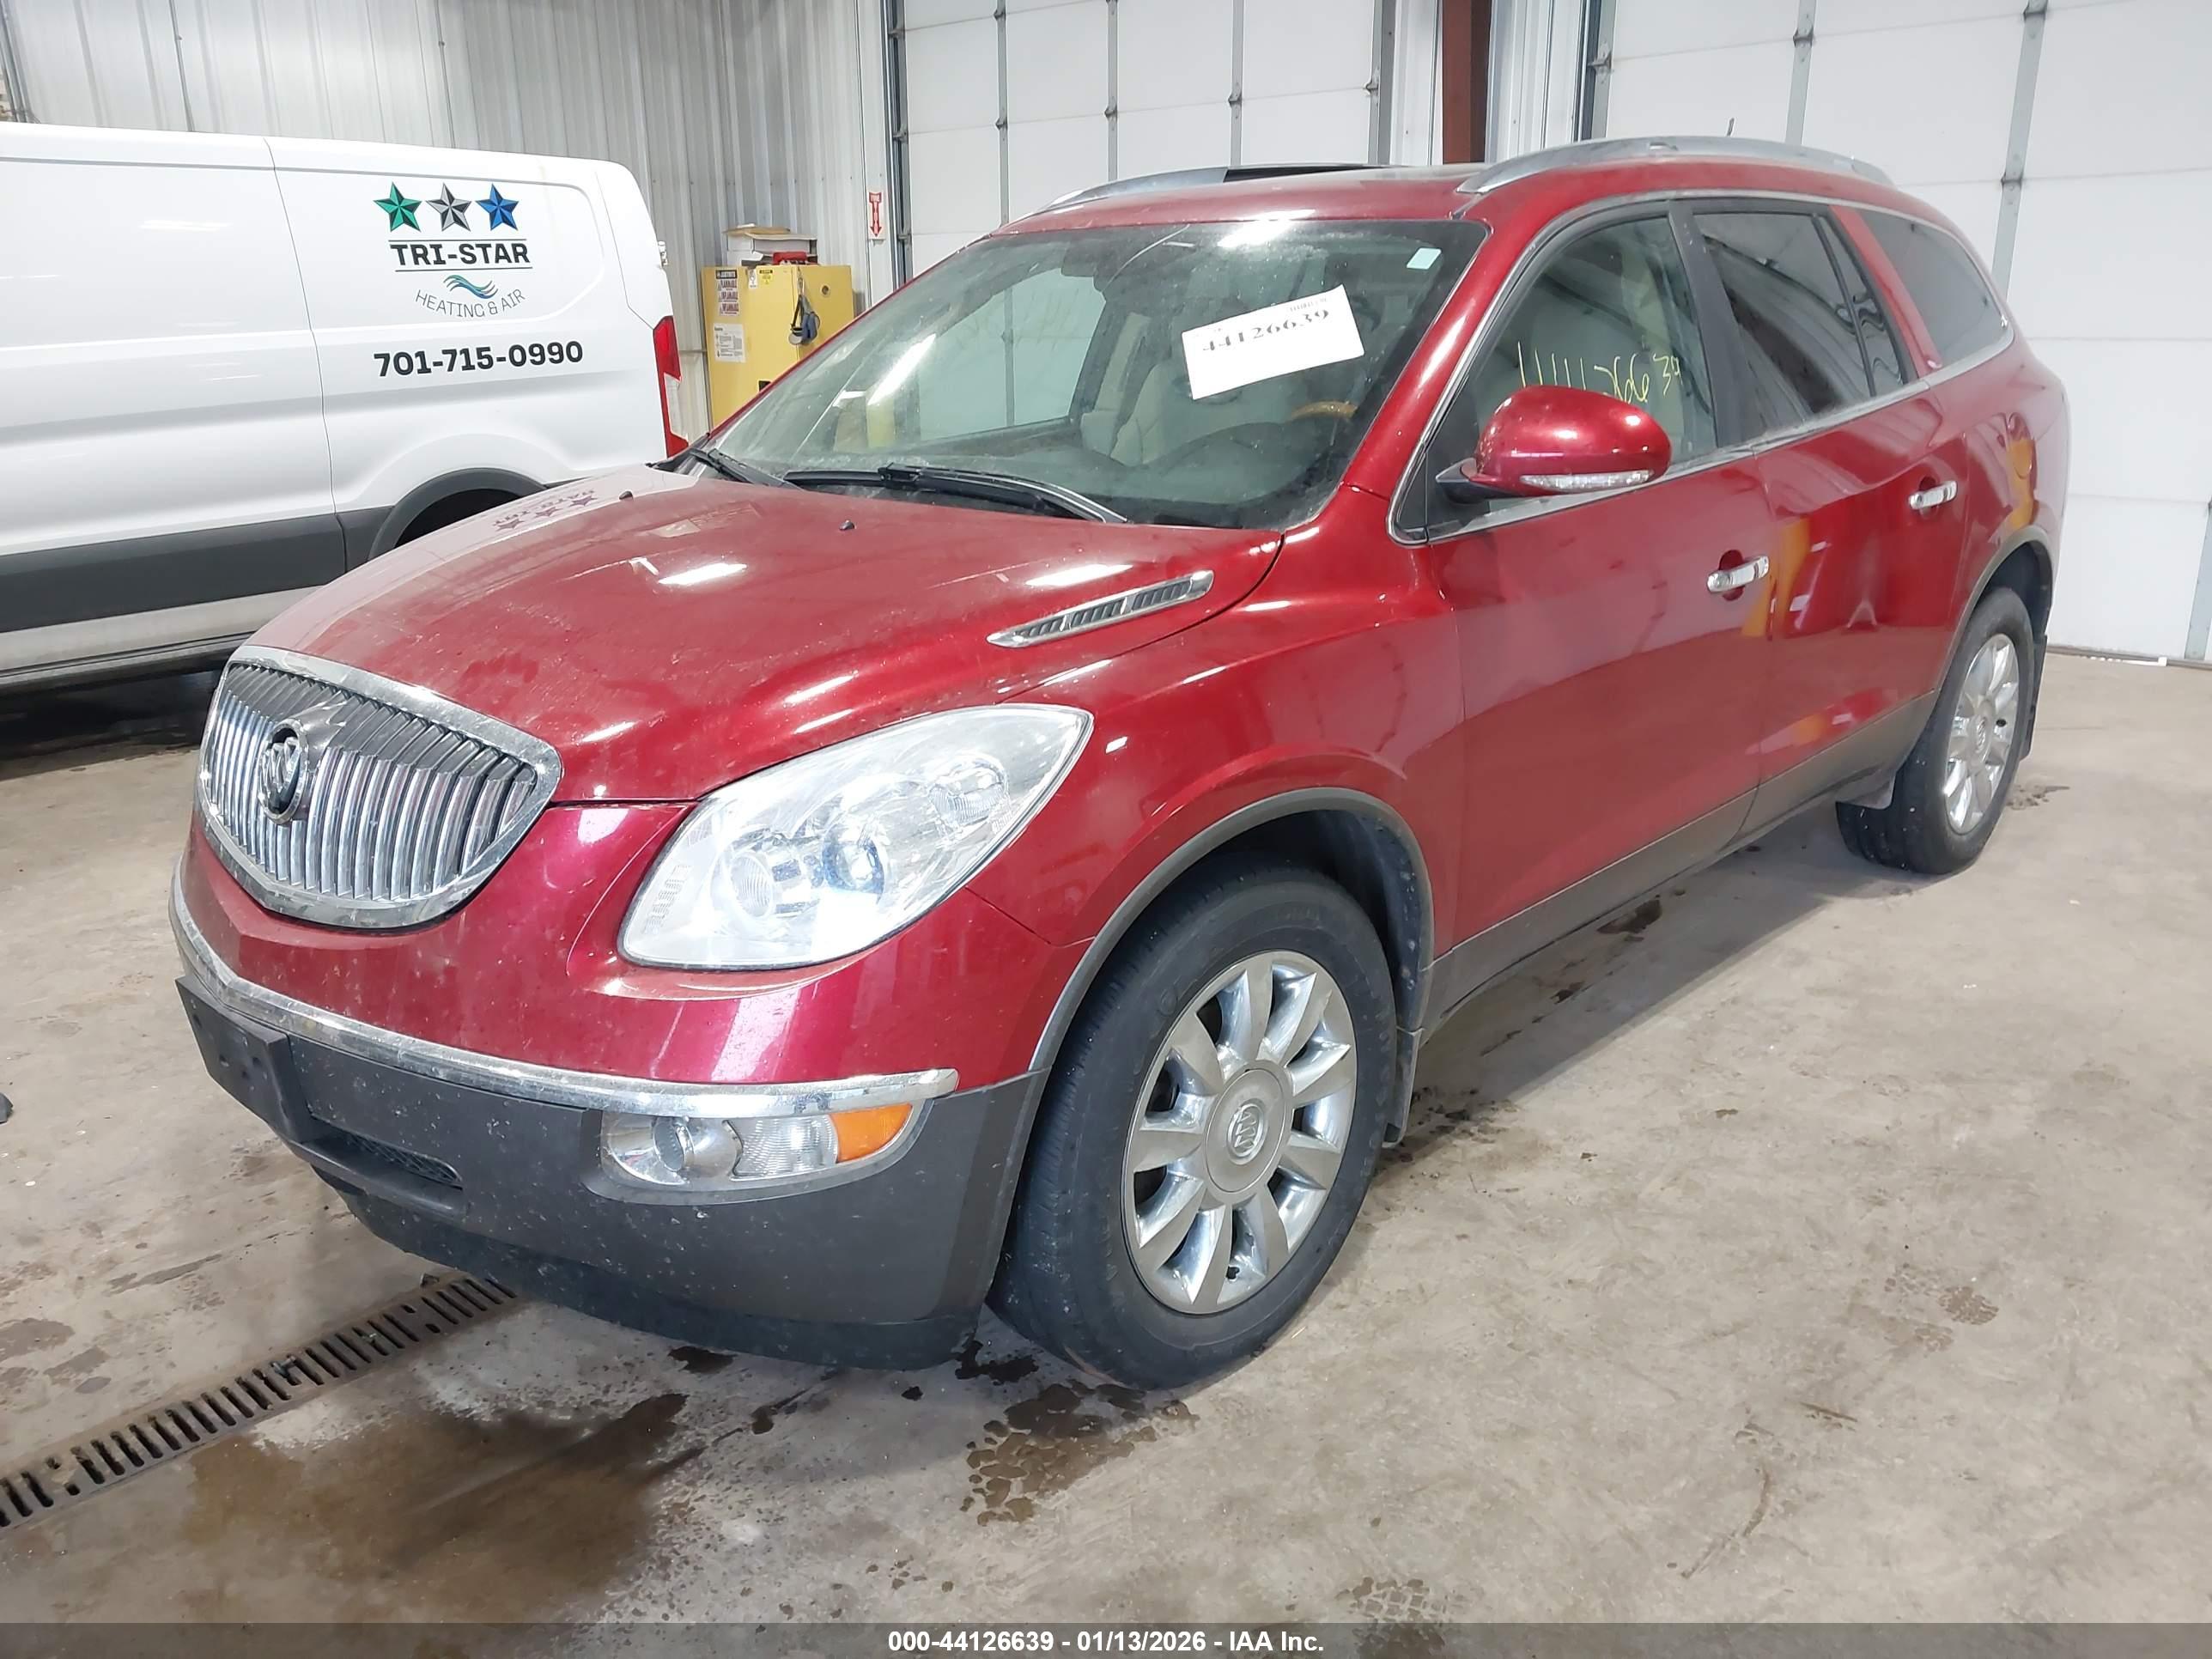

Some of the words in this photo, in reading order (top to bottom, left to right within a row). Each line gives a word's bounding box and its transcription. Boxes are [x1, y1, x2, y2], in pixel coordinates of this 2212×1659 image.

[390, 243, 530, 265] TRI-STAR
[416, 289, 485, 318] HEATING
[488, 301, 498, 315] &
[501, 289, 526, 311] AIR
[374, 341, 583, 376] 701-715-0990
